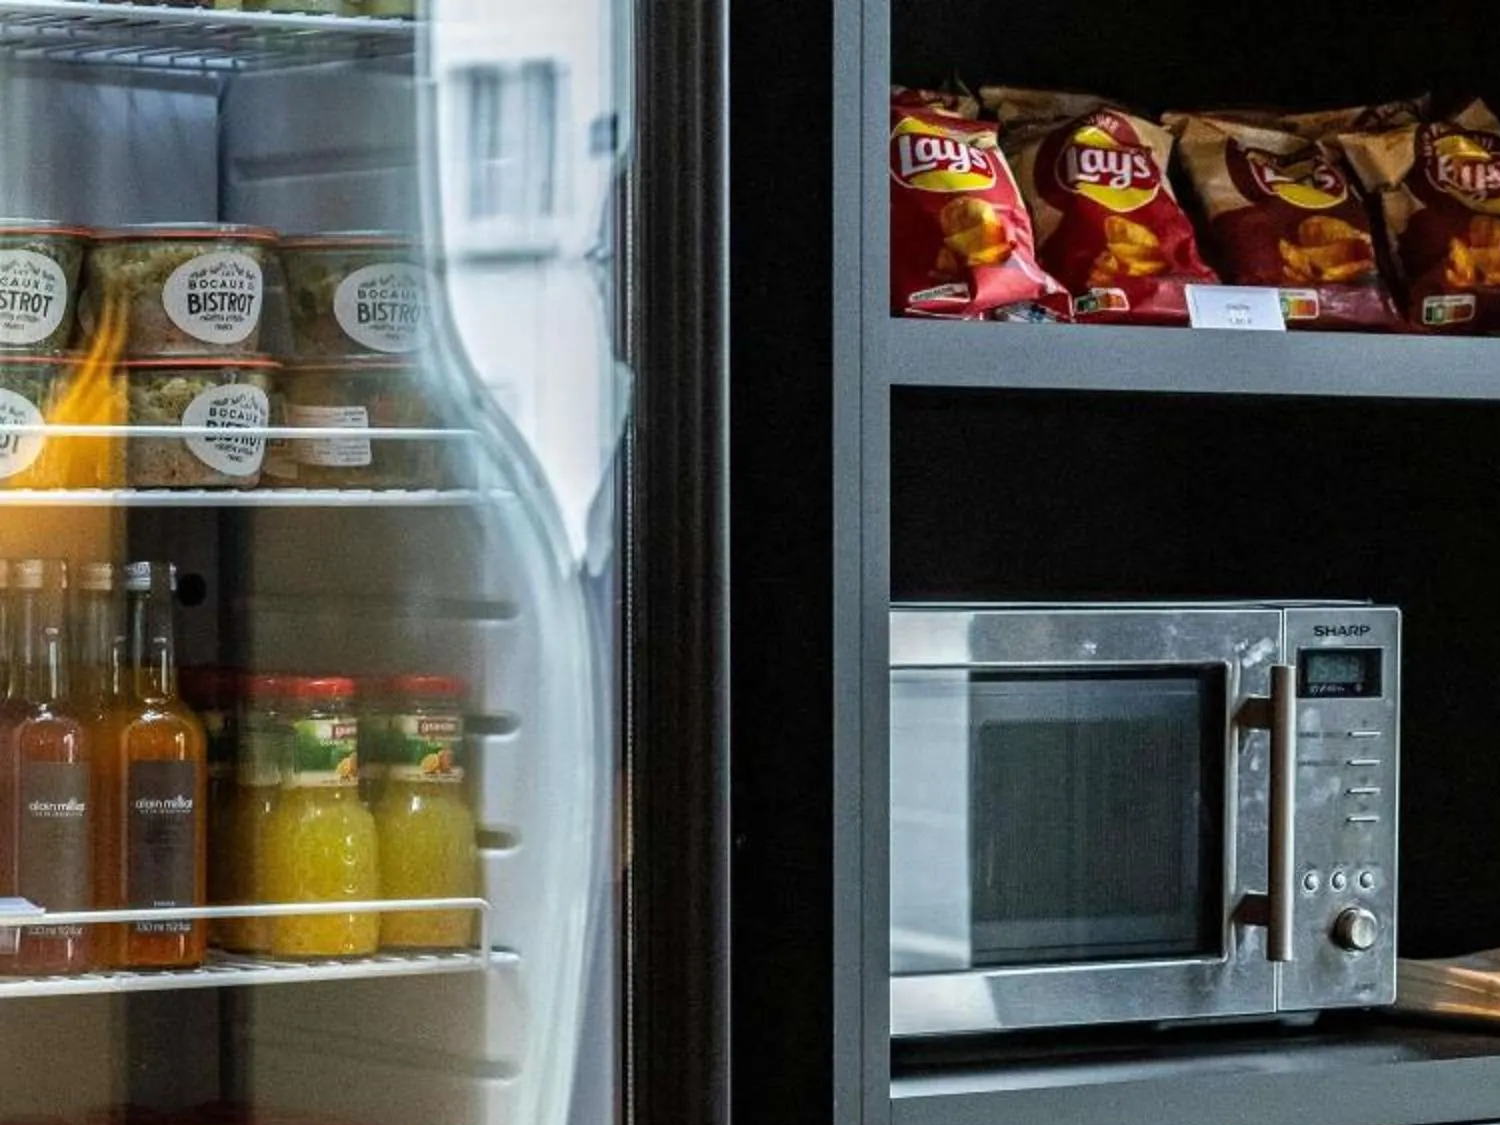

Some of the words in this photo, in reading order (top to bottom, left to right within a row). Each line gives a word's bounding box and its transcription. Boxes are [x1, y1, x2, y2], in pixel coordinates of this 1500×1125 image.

[898, 134, 988, 178] Lays
[188, 279, 245, 290] BOCAUX
[0, 289, 53, 318] STROT
[187, 291, 255, 316] BISTROT
[1313, 624, 1371, 637] SHARP
